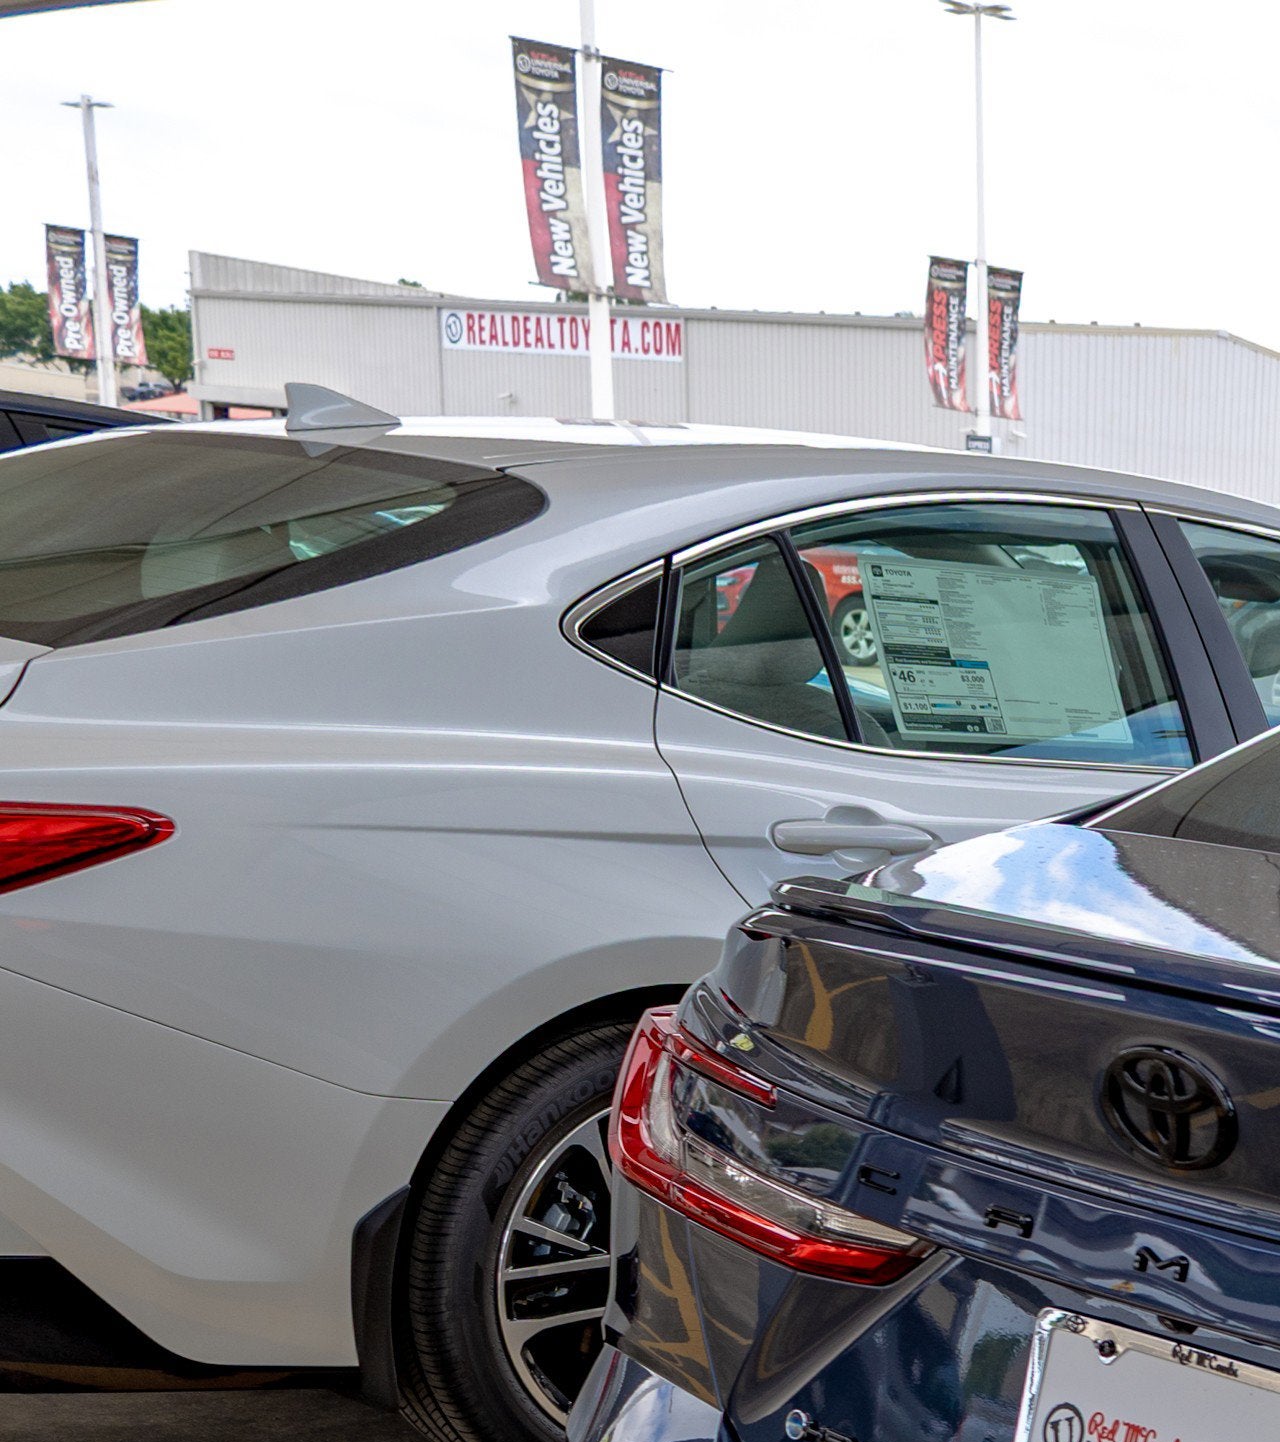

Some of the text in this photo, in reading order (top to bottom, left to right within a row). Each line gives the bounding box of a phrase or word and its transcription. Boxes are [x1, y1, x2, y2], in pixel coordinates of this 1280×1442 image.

[532, 102, 578, 277] New Vehicles
[617, 117, 650, 288] New Vehicles
[54, 256, 78, 318] Owned
[108, 264, 130, 325] Owned
[65, 321, 84, 350] Pre
[116, 328, 135, 357] Pre
[466, 312, 682, 356] REALDEALTOYTA.COM
[947, 295, 960, 389] MAINTENANCE
[1000, 305, 1013, 397] MAINTENANCE
[884, 568, 912, 577] TOYOTA
[899, 670, 916, 683] 46
[508, 1068, 616, 1165] Hankoo
